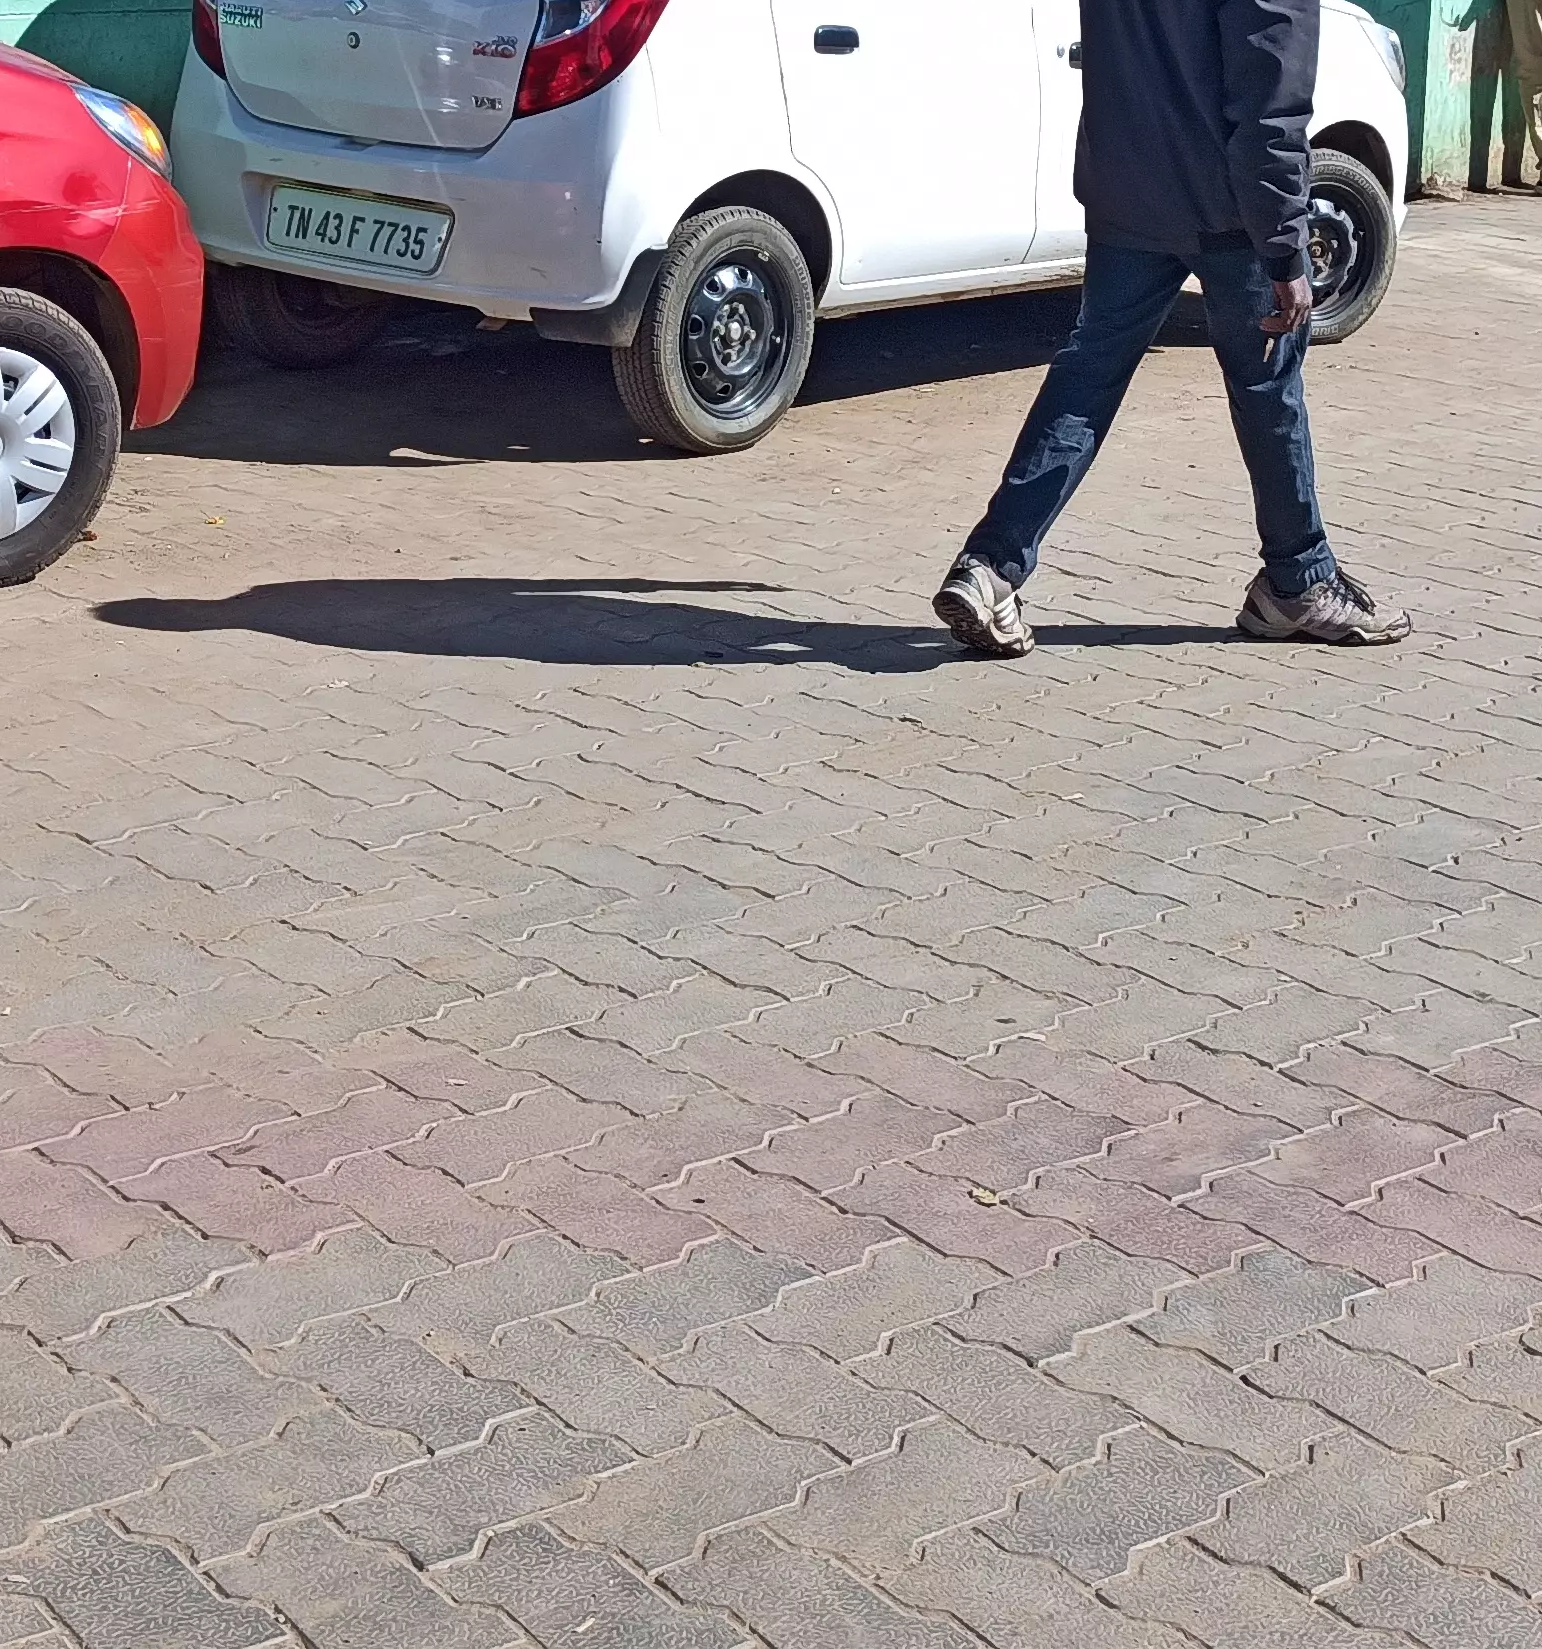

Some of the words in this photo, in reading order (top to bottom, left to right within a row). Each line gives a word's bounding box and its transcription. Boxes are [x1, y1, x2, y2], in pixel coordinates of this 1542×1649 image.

[220, 2, 263, 16] MARUTI
[220, 13, 263, 30] SUZUKI
[472, 39, 518, 59] K10
[285, 204, 313, 240] TN
[314, 210, 344, 245] 43
[346, 215, 366, 248] F
[369, 219, 429, 261] 7735
